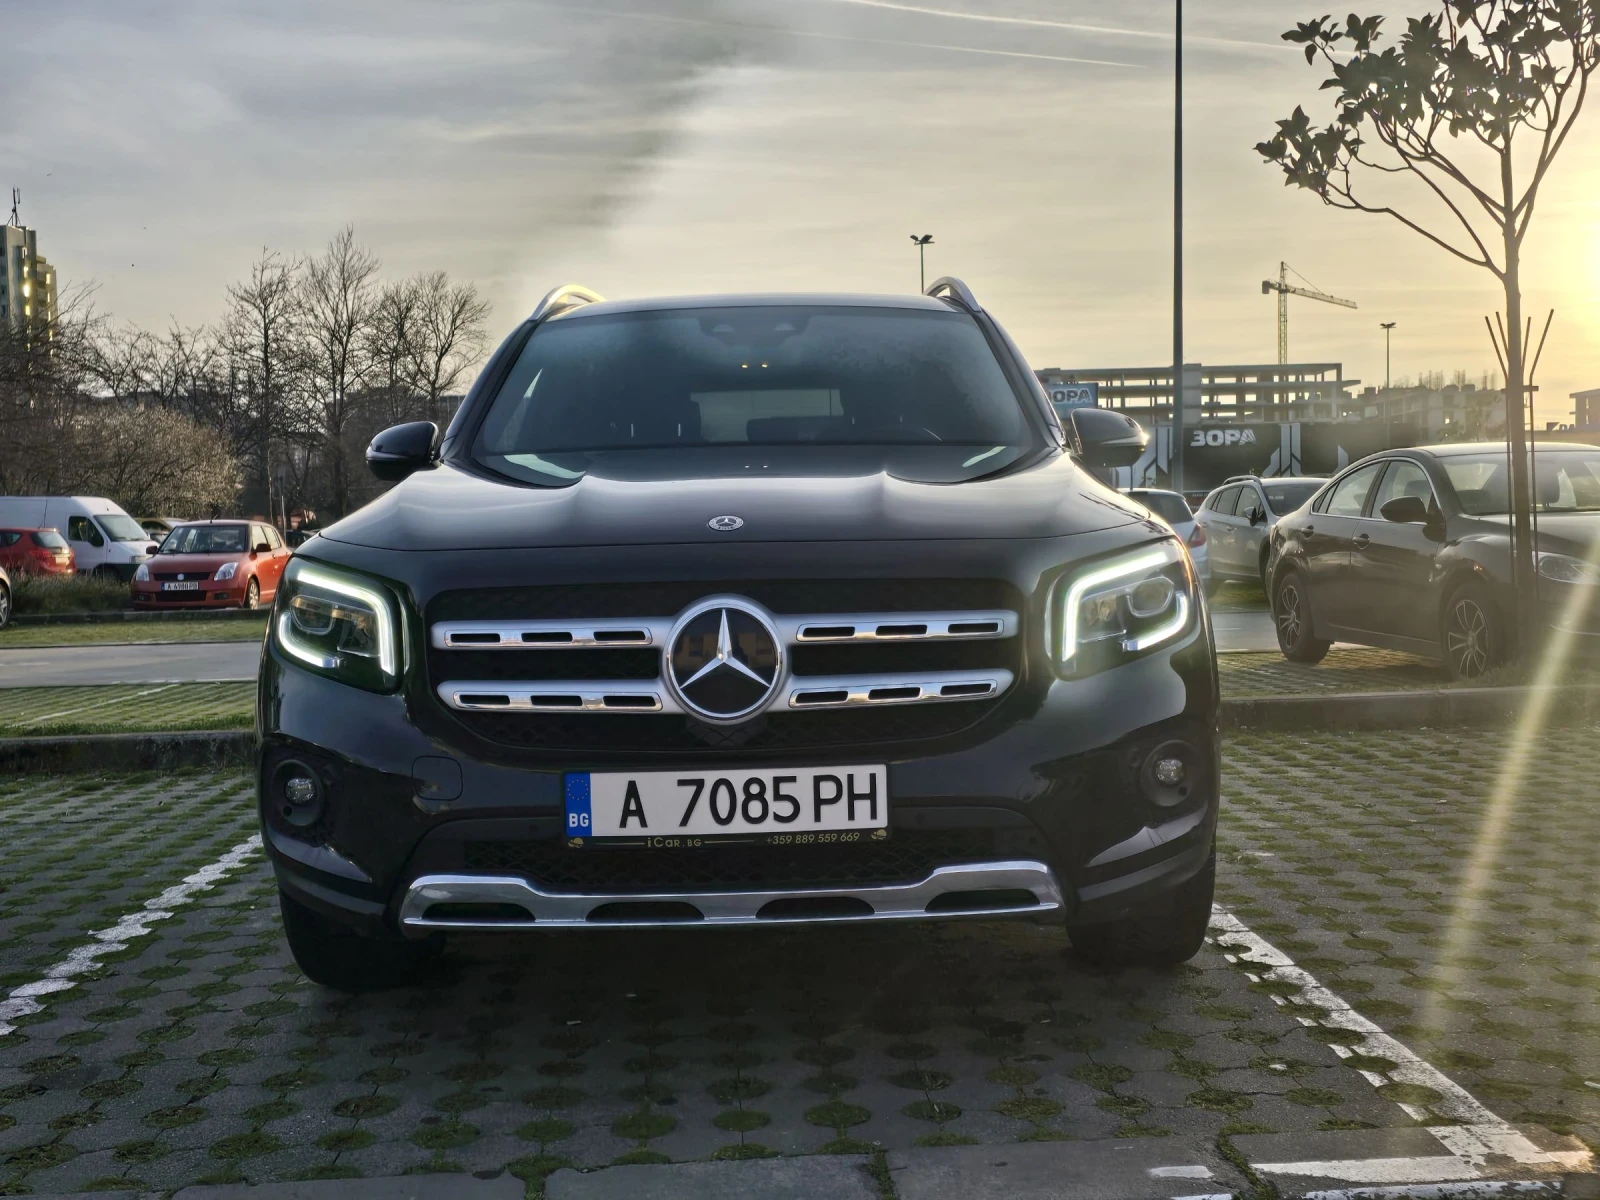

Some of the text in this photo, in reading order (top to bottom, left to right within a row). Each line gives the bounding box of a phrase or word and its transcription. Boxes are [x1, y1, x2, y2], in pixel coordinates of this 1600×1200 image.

[619, 773, 877, 828] A 7085 PH
[568, 813, 589, 827] BG
[767, 832, 860, 845] +359 889 559 669
